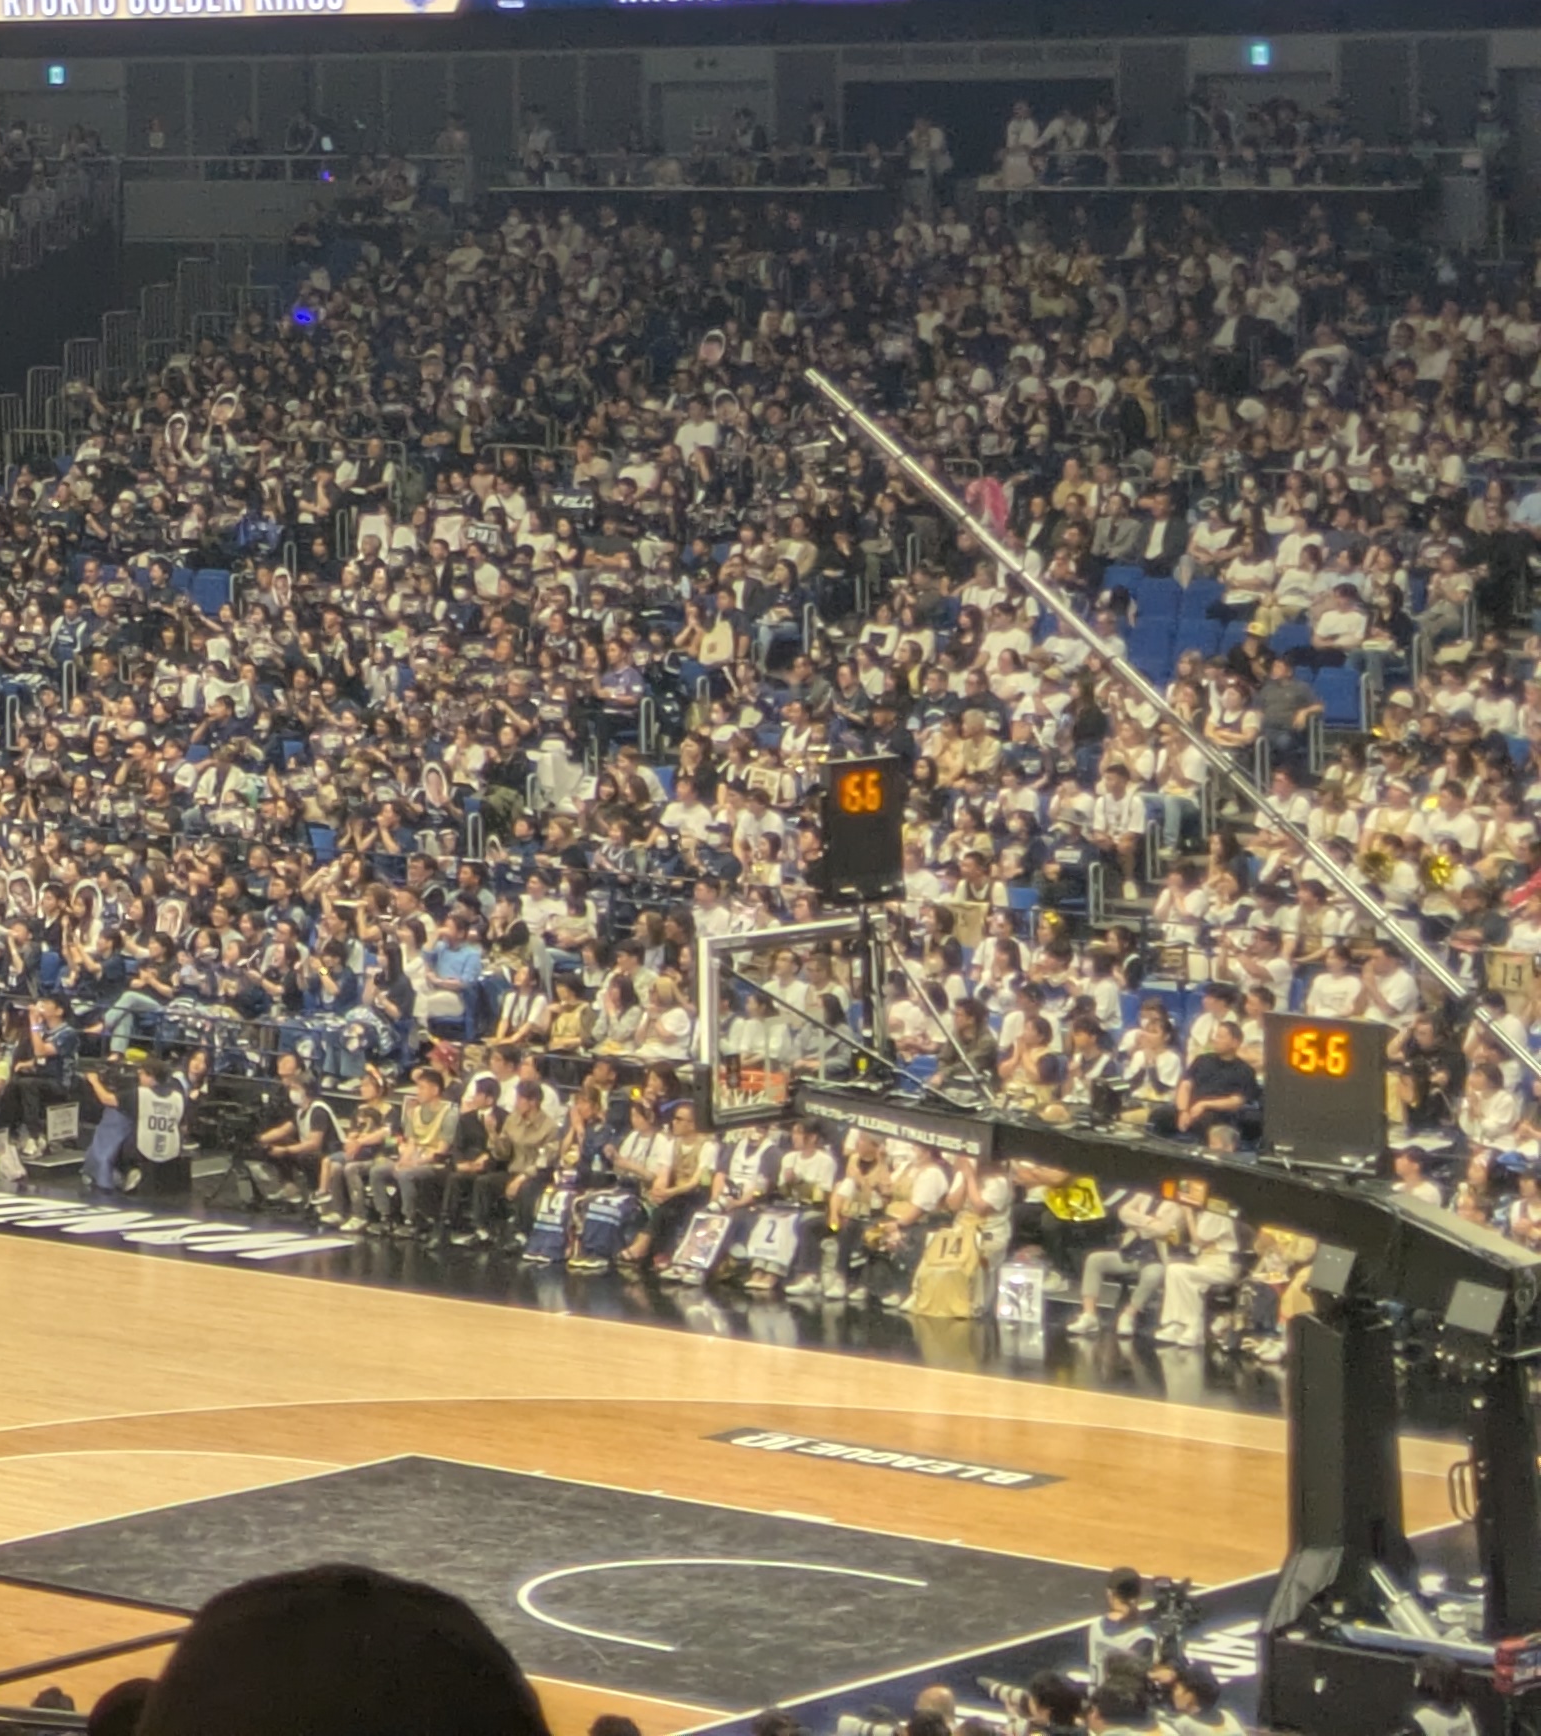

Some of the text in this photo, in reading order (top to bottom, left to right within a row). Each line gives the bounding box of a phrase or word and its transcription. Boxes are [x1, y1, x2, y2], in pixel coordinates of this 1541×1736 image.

[148, 1115, 177, 1134] 002
[763, 1219, 776, 1244] 2
[939, 1236, 964, 1260] 14
[795, 1439, 1035, 1486] B.LEAGUE
